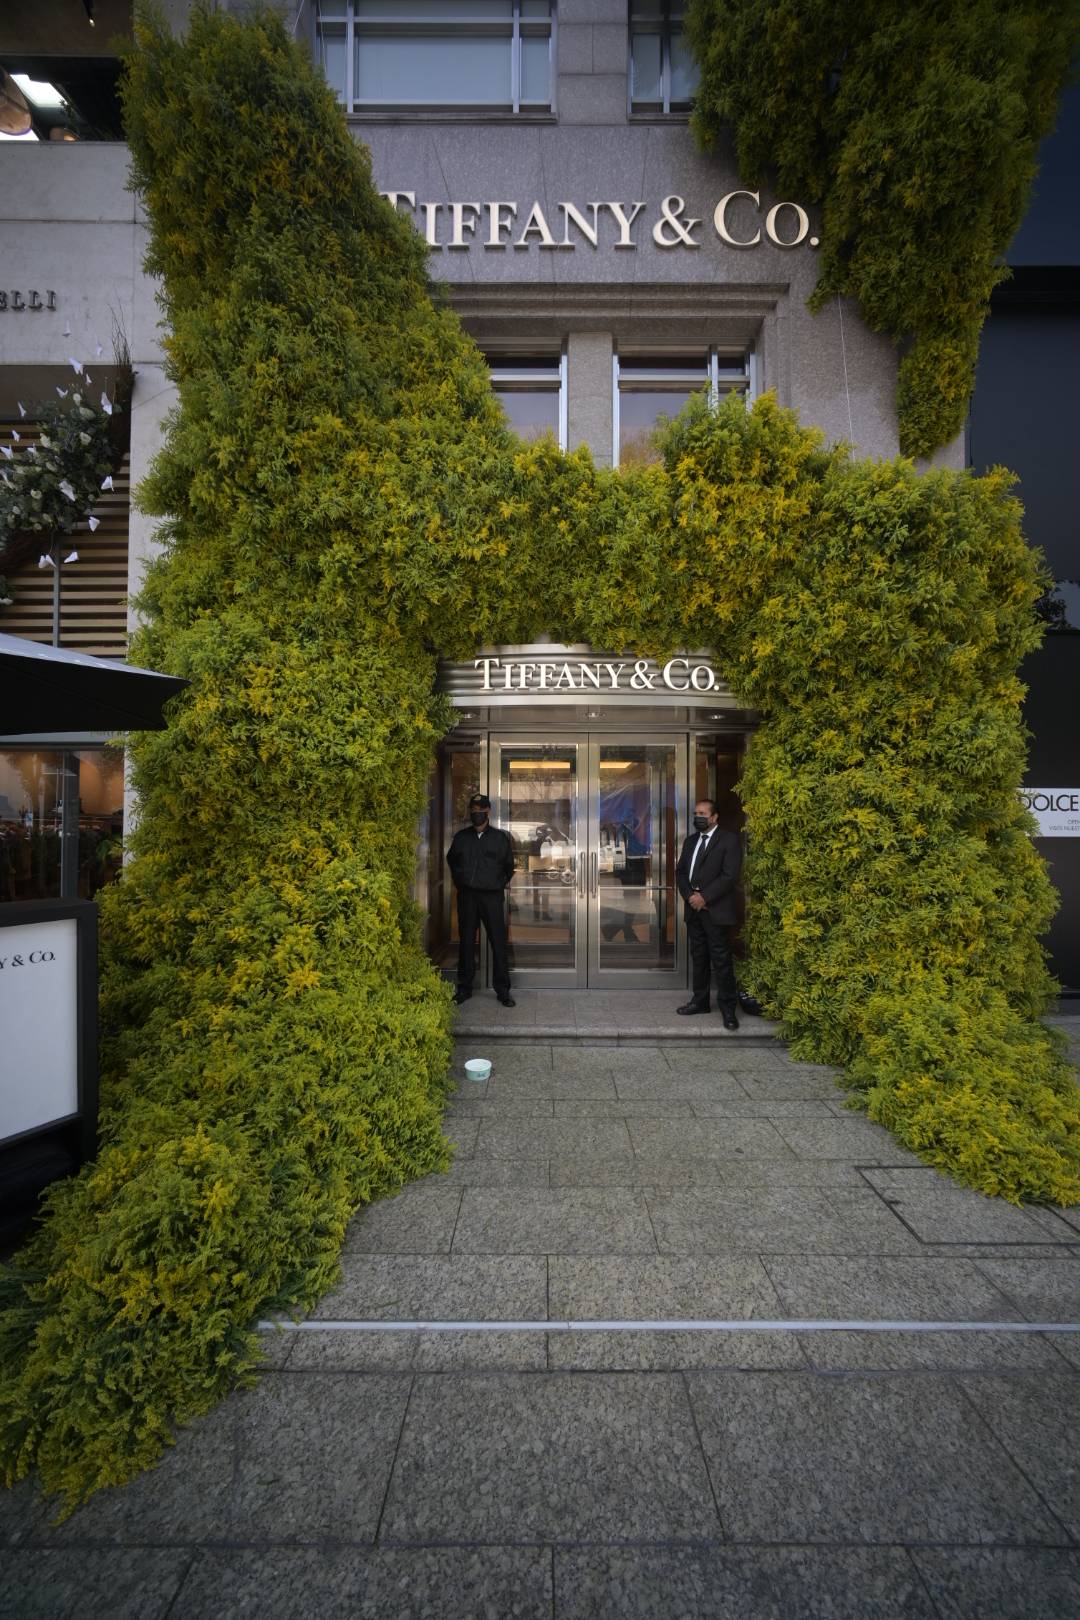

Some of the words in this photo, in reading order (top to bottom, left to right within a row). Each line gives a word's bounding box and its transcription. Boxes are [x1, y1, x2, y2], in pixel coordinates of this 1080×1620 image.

[652, 195, 702, 247] &
[475, 658, 625, 690] TIFFANY
[629, 660, 657, 690] &
[11, 954, 24, 967] &
